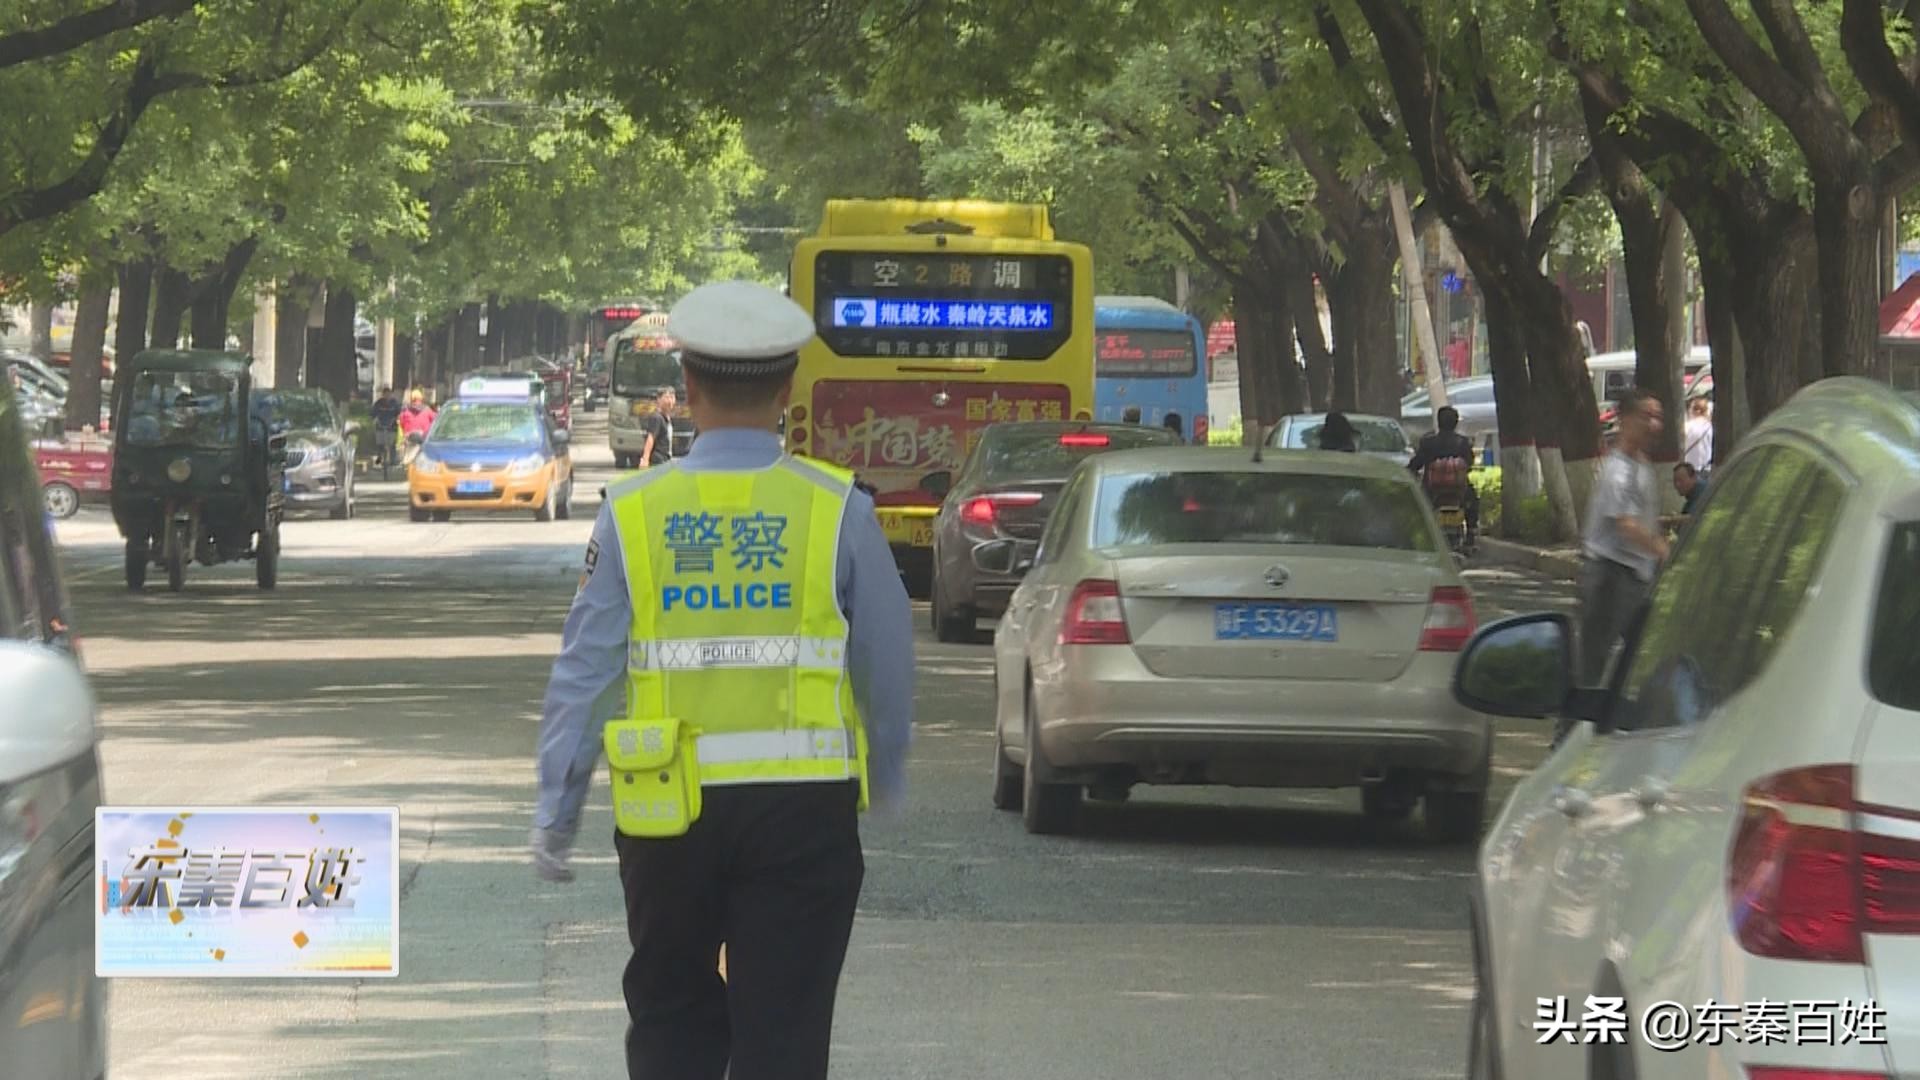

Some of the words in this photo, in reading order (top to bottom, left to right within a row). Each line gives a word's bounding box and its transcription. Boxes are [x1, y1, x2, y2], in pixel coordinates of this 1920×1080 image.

[947, 303, 1048, 327] 秦岭天泉水
[966, 398, 1062, 421] 国家富强
[848, 406, 960, 469] 中国梦
[663, 511, 789, 574] 警察
[662, 583, 792, 611] POLICE
[702, 645, 754, 660] POLICE
[618, 726, 665, 756] 警察
[621, 799, 677, 820] POLICE
